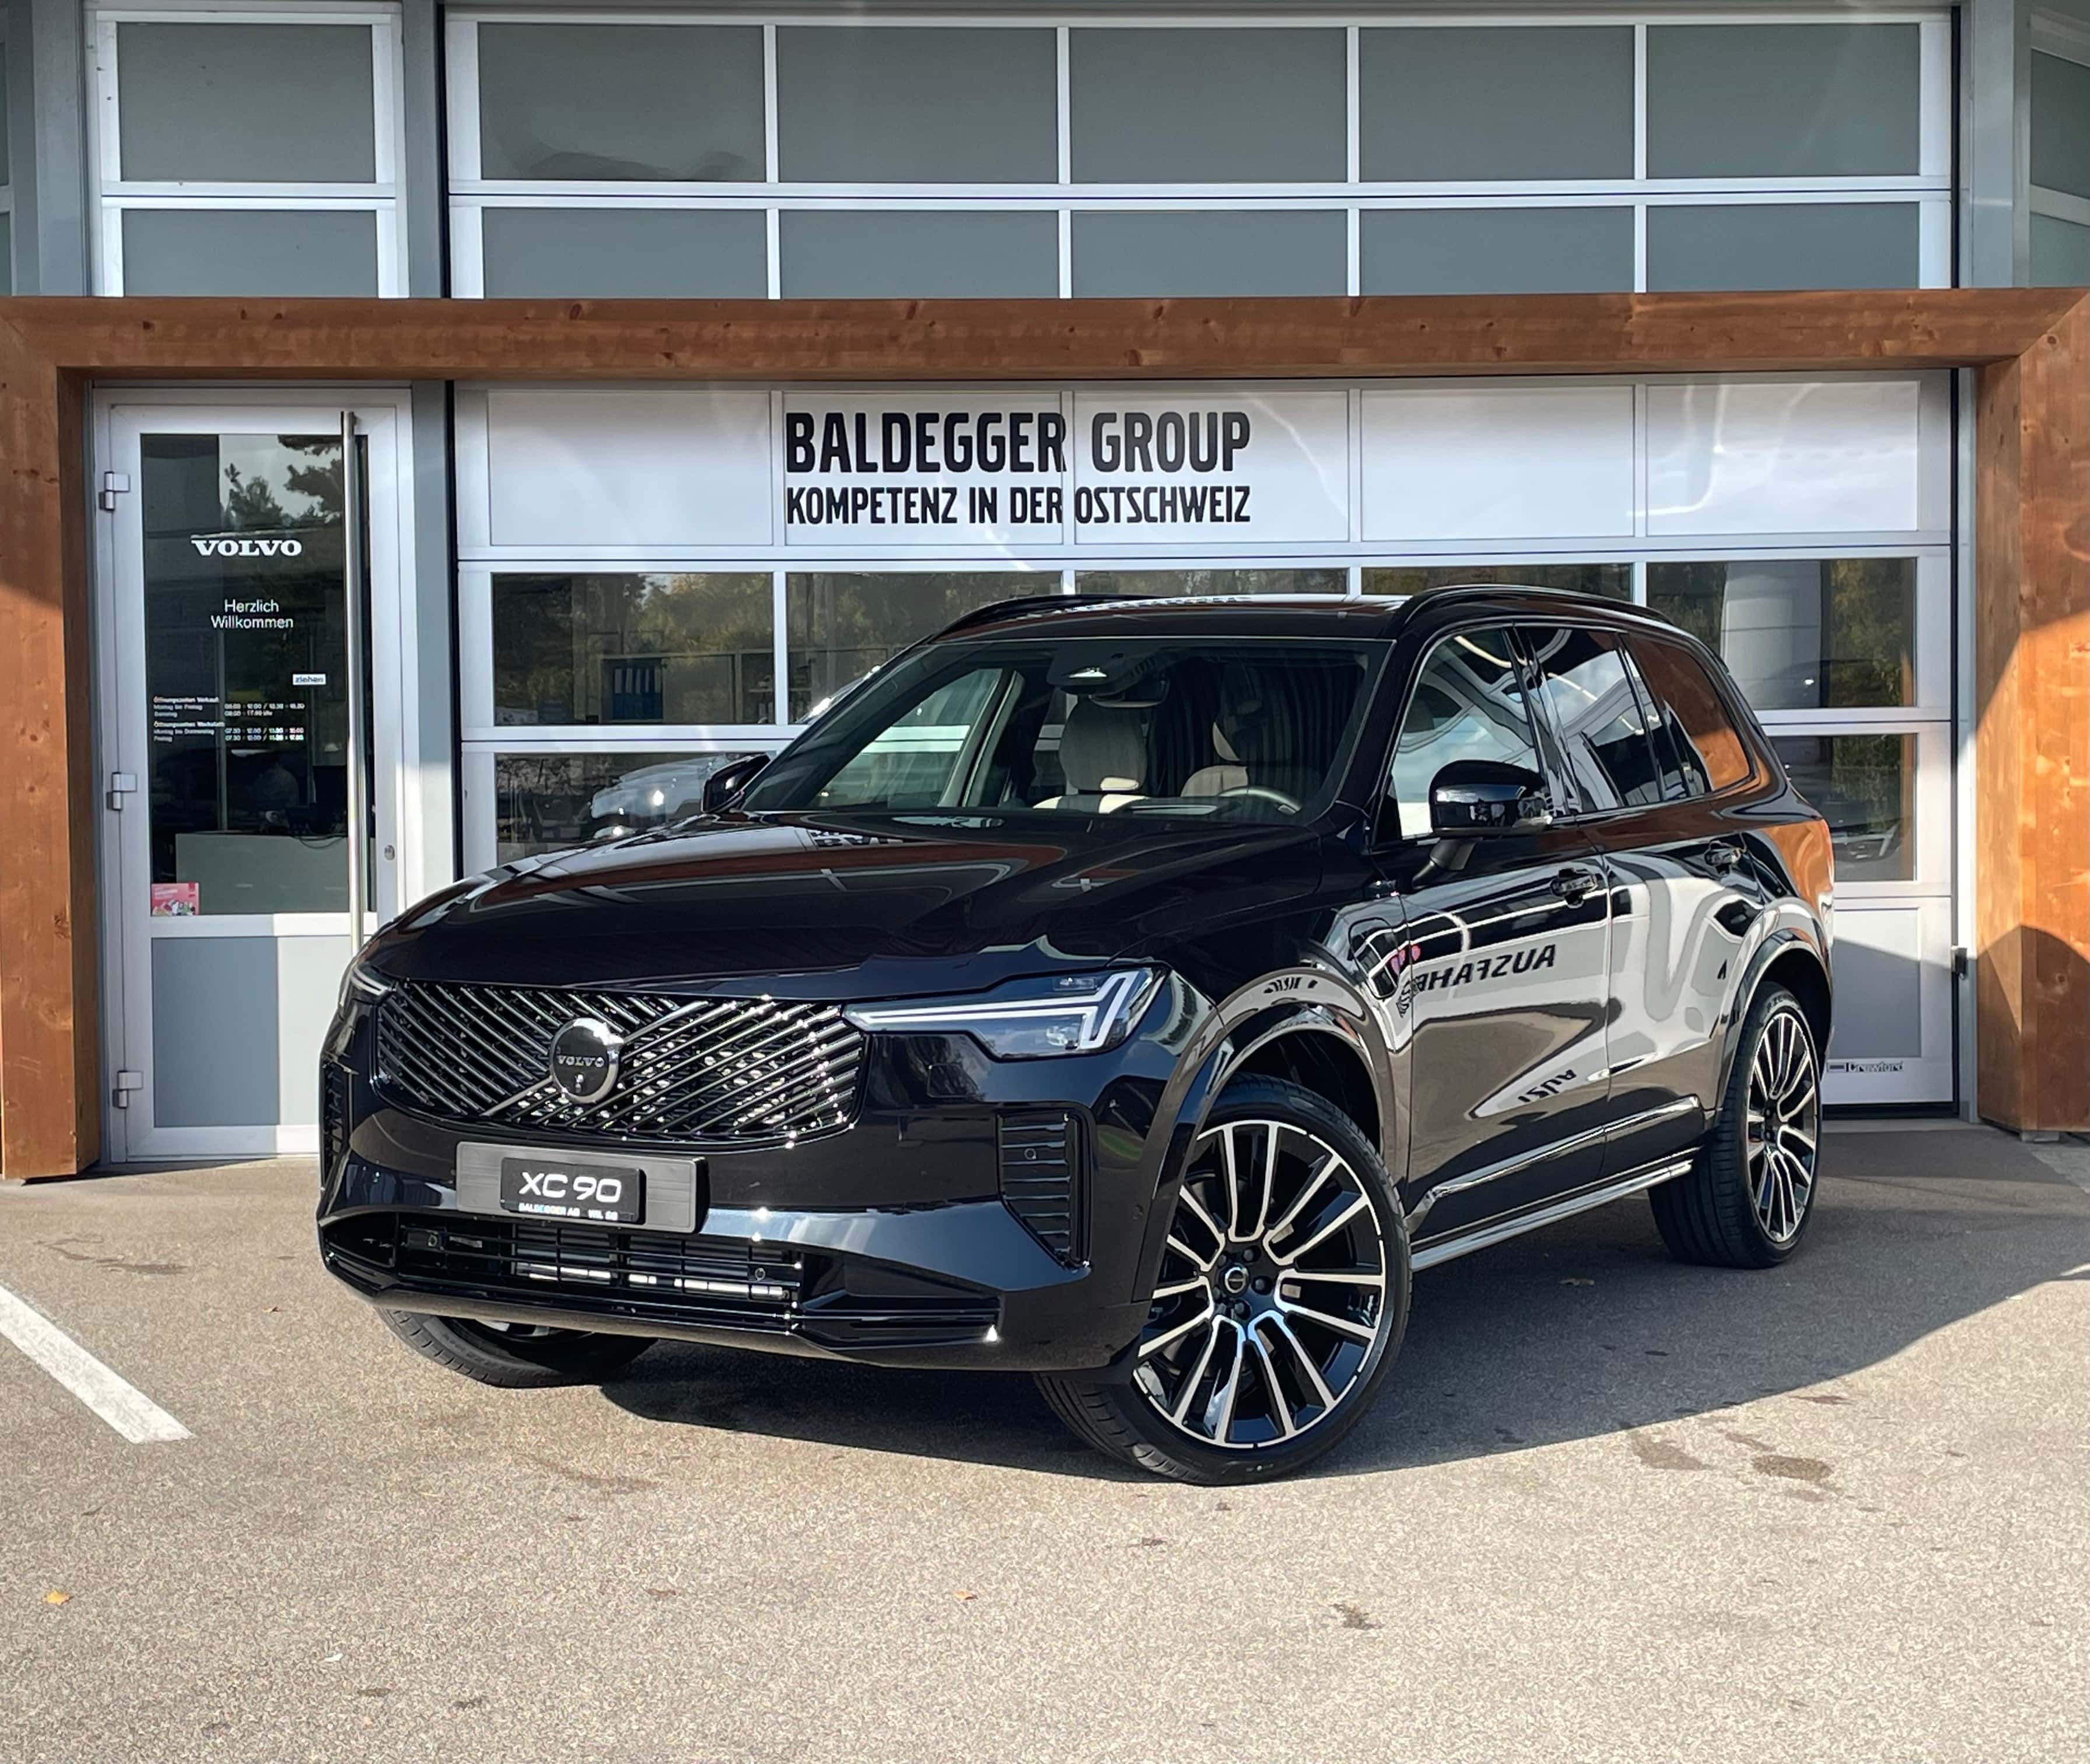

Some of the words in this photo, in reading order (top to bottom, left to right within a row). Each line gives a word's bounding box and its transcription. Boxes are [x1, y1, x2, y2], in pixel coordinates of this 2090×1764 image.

[786, 412, 1066, 473] BALDEGGER
[1091, 412, 1251, 473] GROUP
[787, 487, 957, 524] KOMPETENZ
[969, 487, 997, 524] IN
[1010, 487, 1062, 524] DER
[1075, 487, 1251, 524] OSTSCHWEIZ
[191, 540, 302, 556] VOLVO
[225, 599, 279, 612] Herzlich
[211, 615, 294, 629] Willkommen
[557, 1055, 604, 1068] VOLVO
[519, 1172, 569, 1198] XC
[573, 1176, 622, 1203] 90
